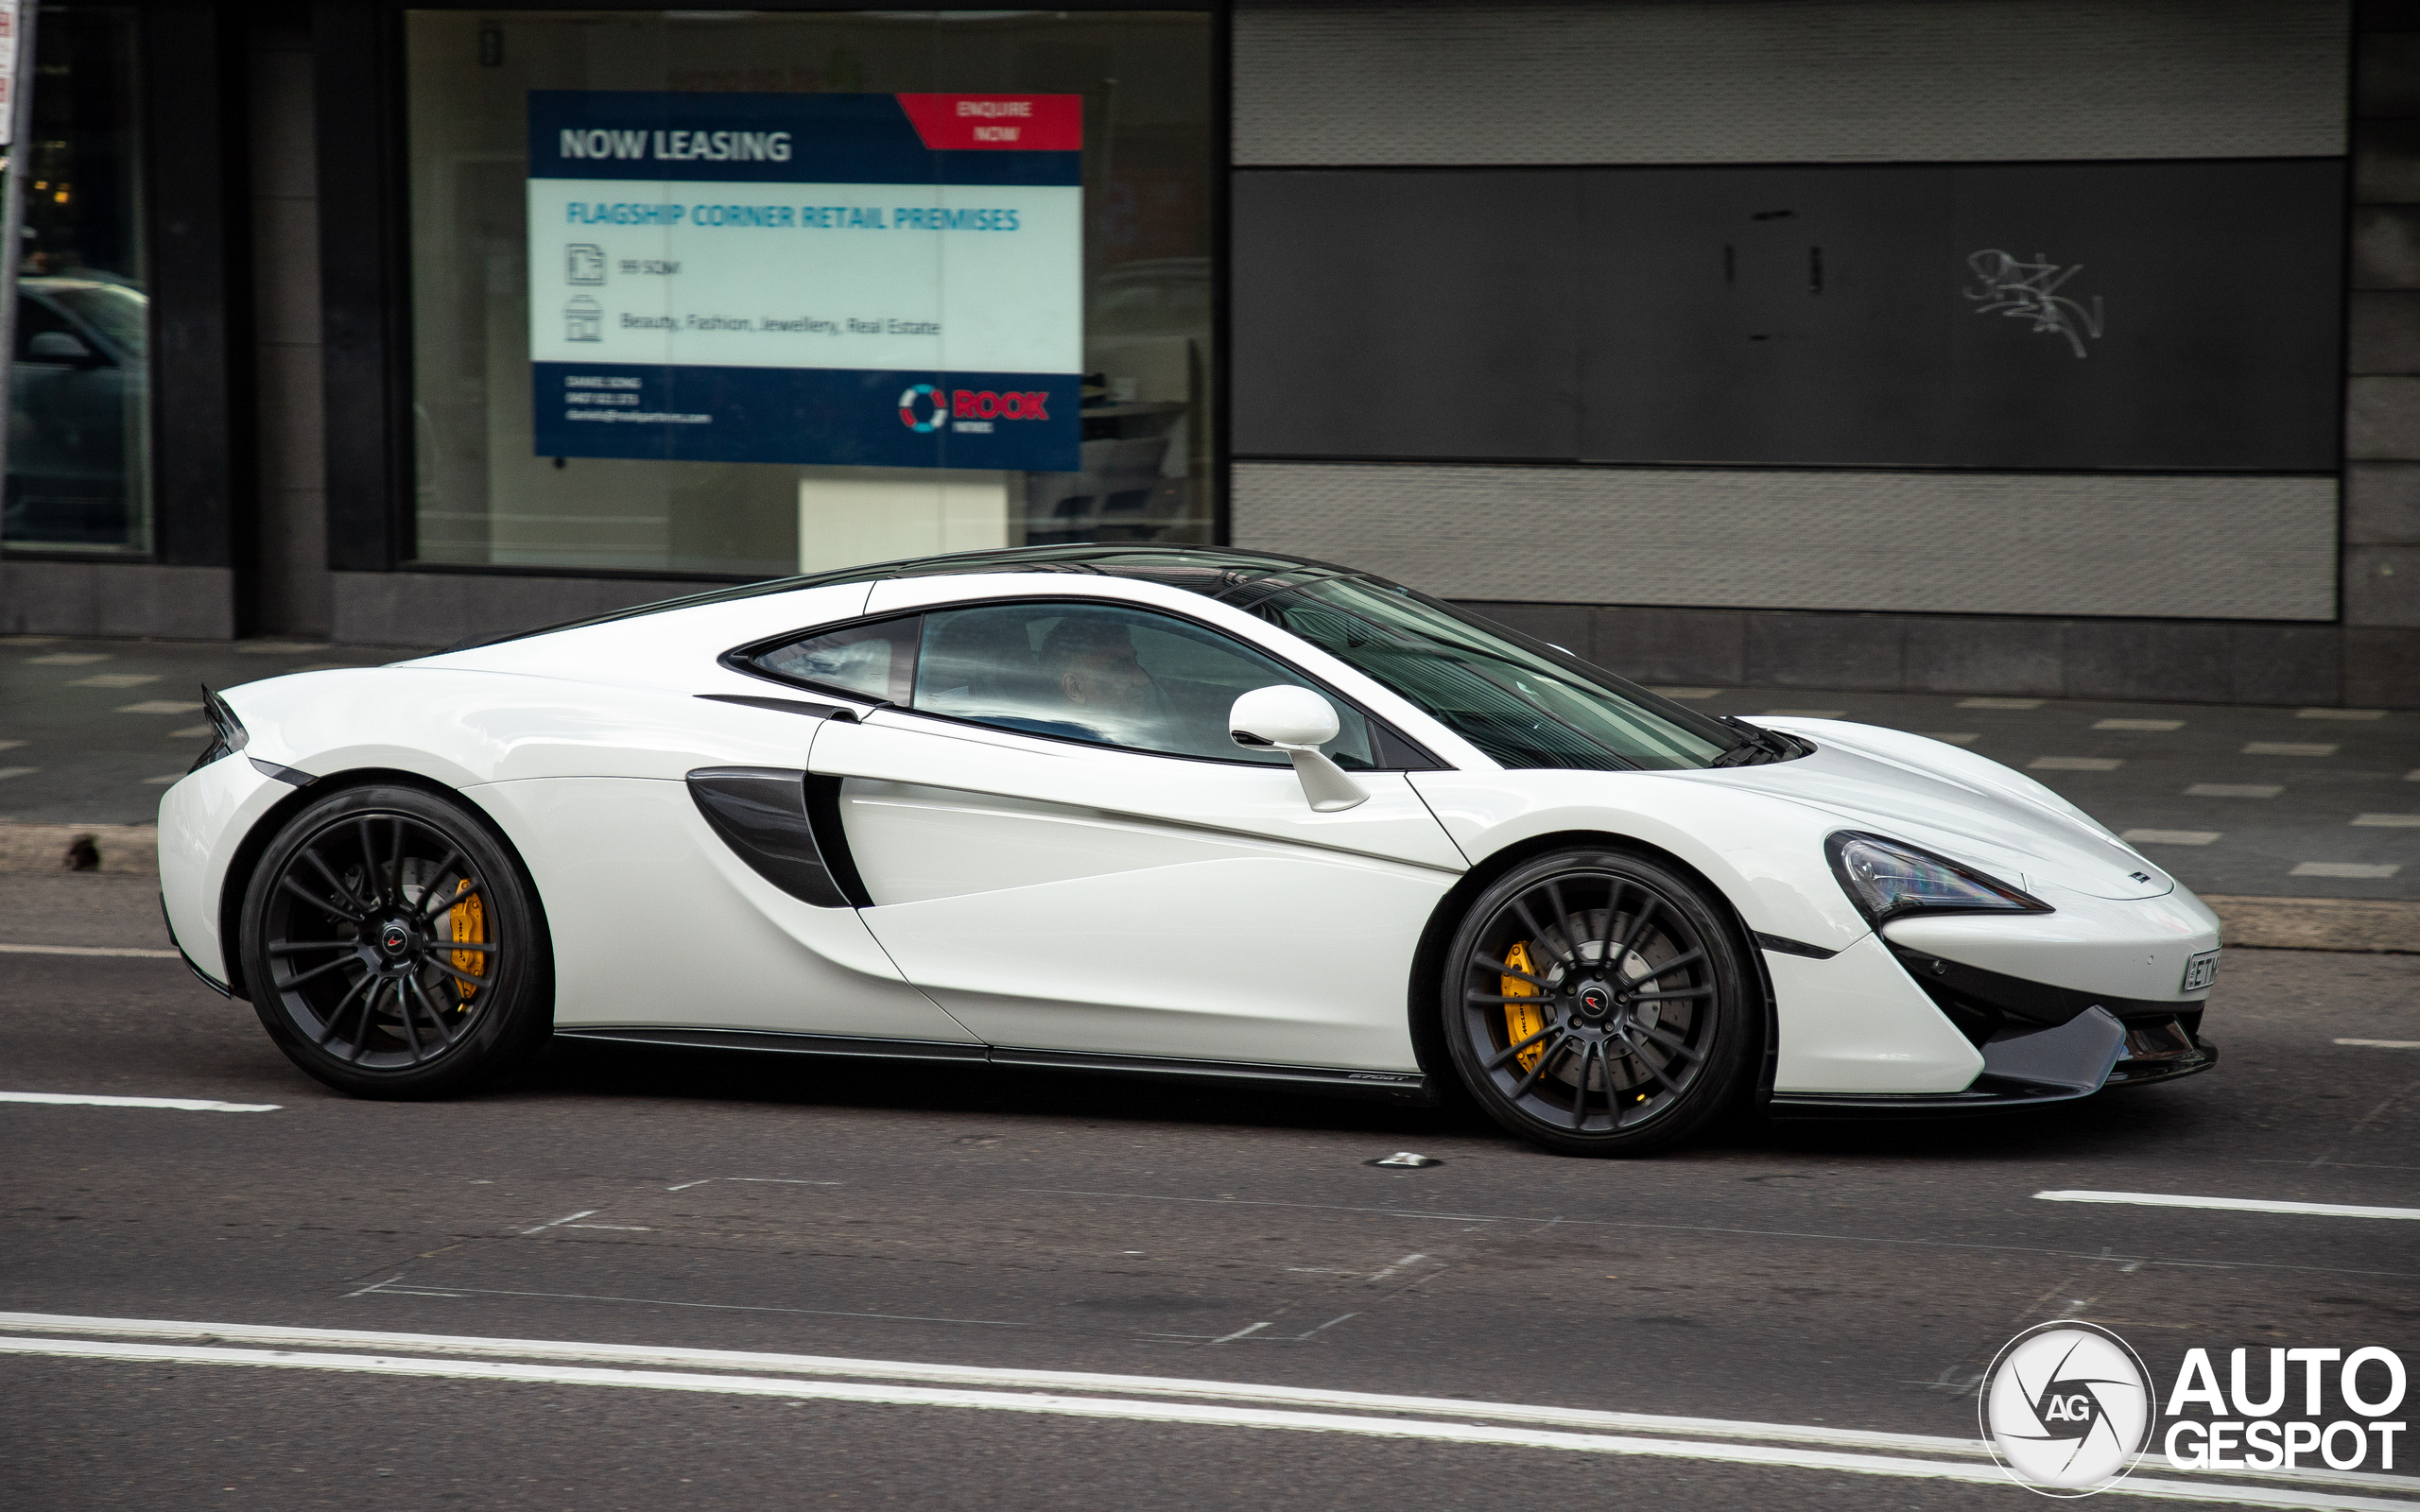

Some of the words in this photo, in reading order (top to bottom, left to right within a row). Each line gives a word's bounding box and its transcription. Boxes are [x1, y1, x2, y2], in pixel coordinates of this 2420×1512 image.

[956, 101, 1032, 119] ENQUIRE
[561, 129, 648, 159] NOW
[653, 130, 792, 162] LEASING
[973, 126, 1021, 142] NOW
[567, 202, 687, 226] FLAGSHIP
[691, 204, 796, 228] CORNER
[803, 206, 888, 230] RETAIL
[893, 208, 1020, 232] PREMISES
[620, 313, 683, 334] Beauty,
[686, 314, 753, 335] Fashion,
[758, 316, 841, 336] Jewellery,
[847, 318, 885, 334] Real
[888, 318, 942, 335] Estate
[953, 389, 1050, 421] ROOK
